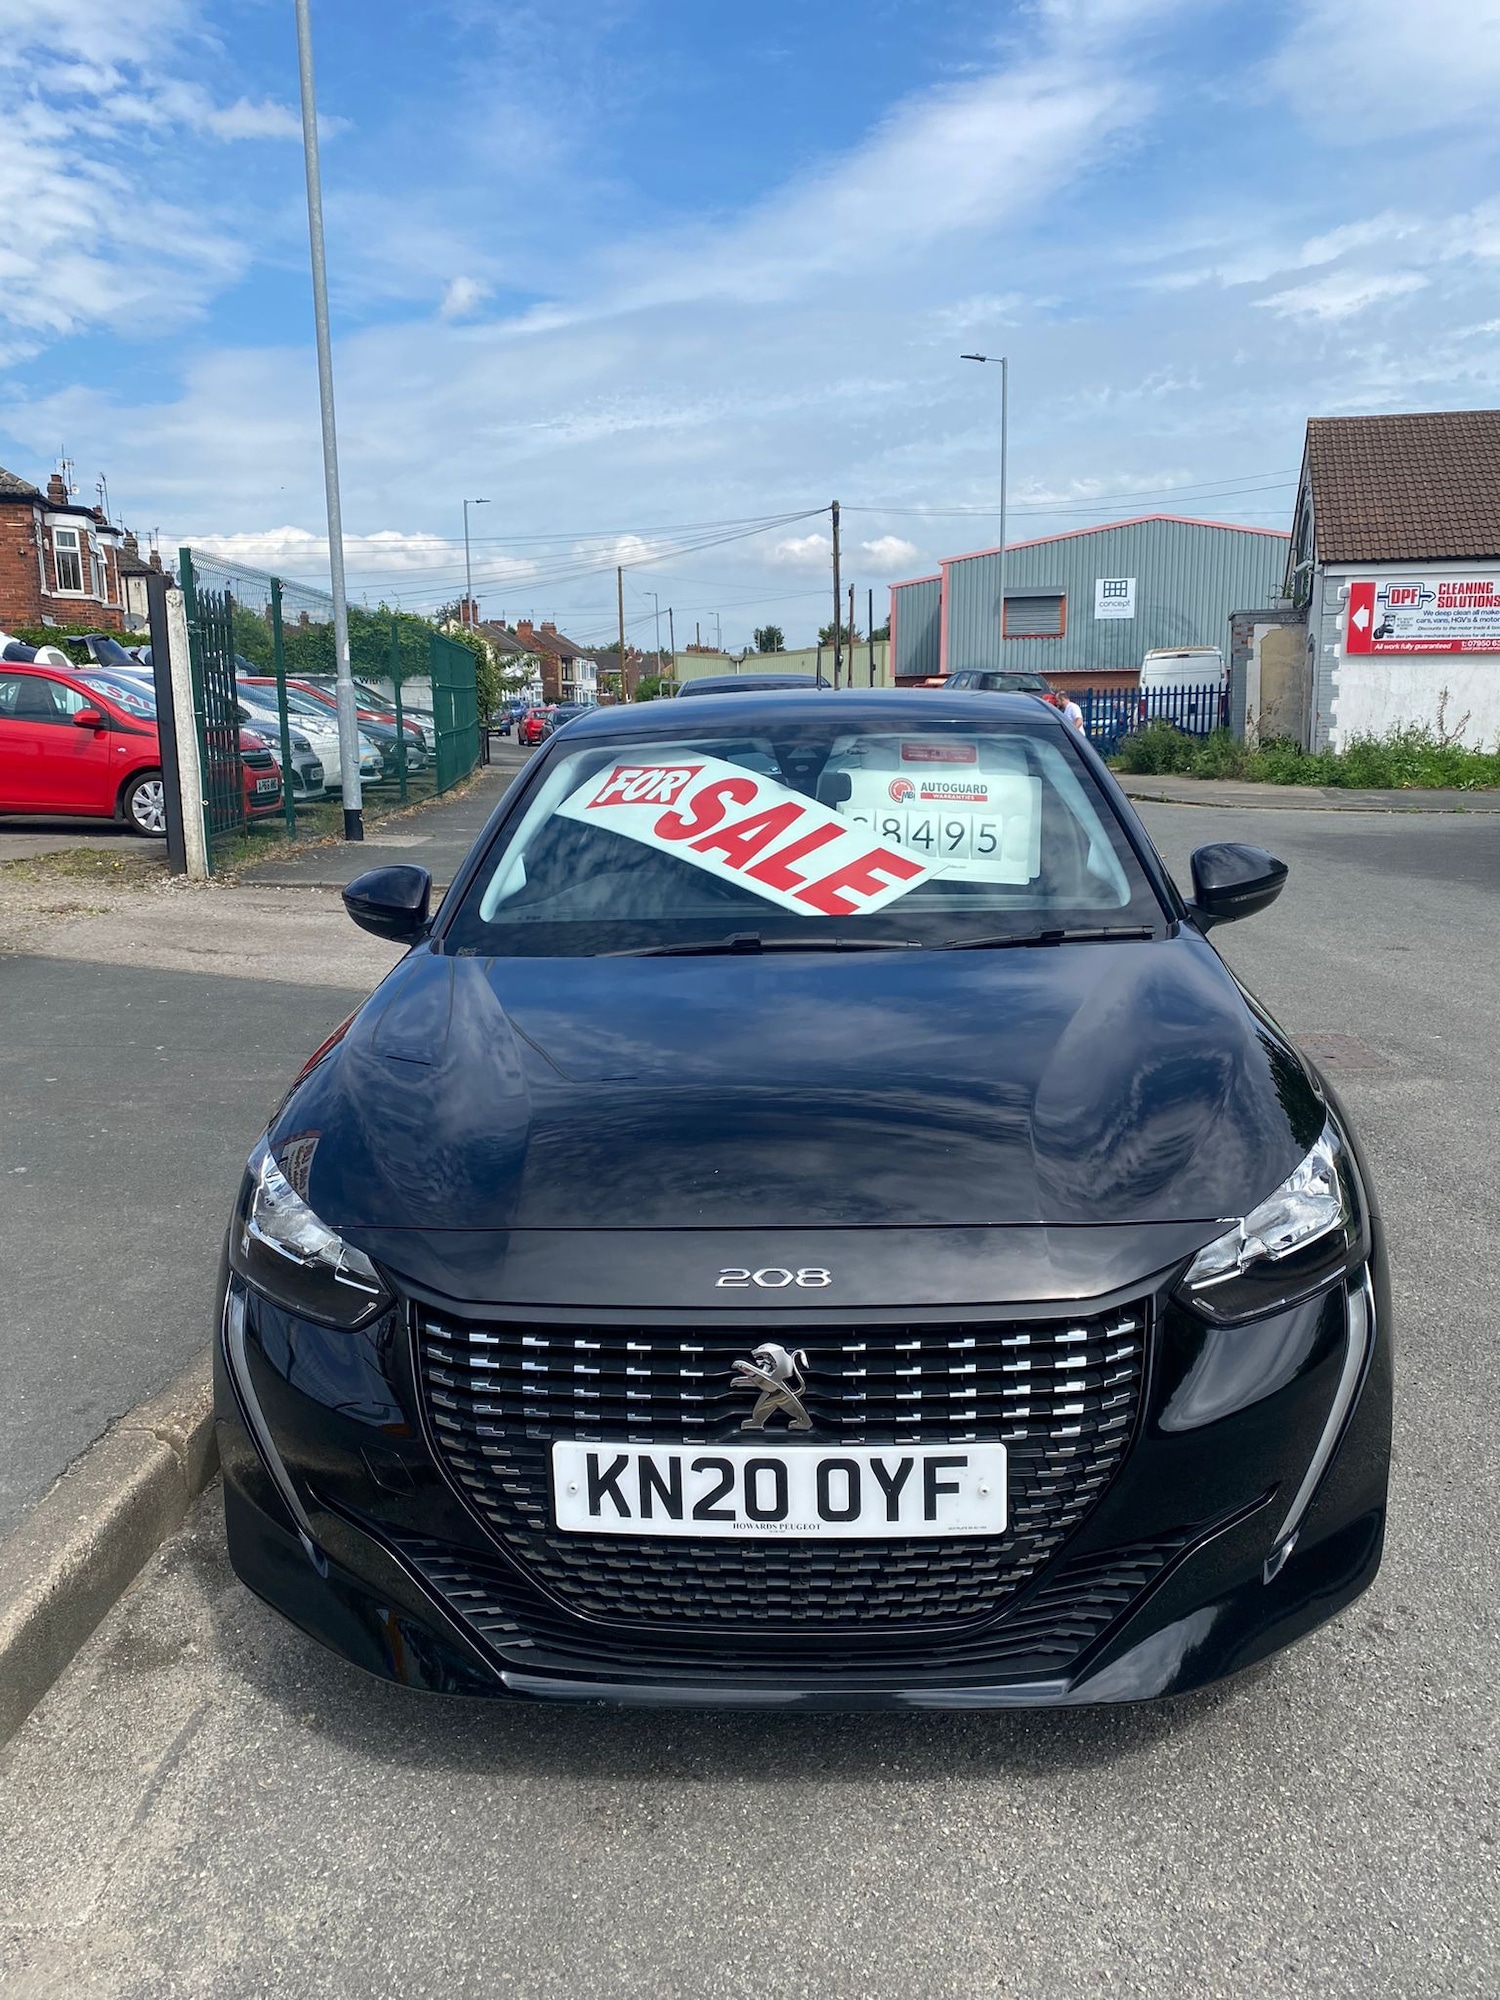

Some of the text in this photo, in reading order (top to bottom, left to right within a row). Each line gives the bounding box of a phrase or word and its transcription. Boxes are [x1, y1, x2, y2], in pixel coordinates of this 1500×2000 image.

[1438, 582, 1494, 595] CLEANING
[1391, 588, 1418, 604] DPF
[1437, 595, 1500, 608] SOLUTIONS
[1099, 600, 1130, 608] concept
[1435, 609, 1452, 617] deep
[1401, 643, 1414, 651] fully
[1415, 643, 1452, 651] guaranteed
[604, 766, 692, 804] FOR
[920, 782, 988, 795] AUTOGUARD
[932, 793, 975, 801] WARRANTIES
[853, 817, 997, 854] 8495
[654, 777, 926, 916] SALE
[715, 1268, 832, 1288] 208
[586, 1453, 968, 1522] KN20 OYF
[732, 1522, 821, 1531] HOWARDS PEUGEOT
